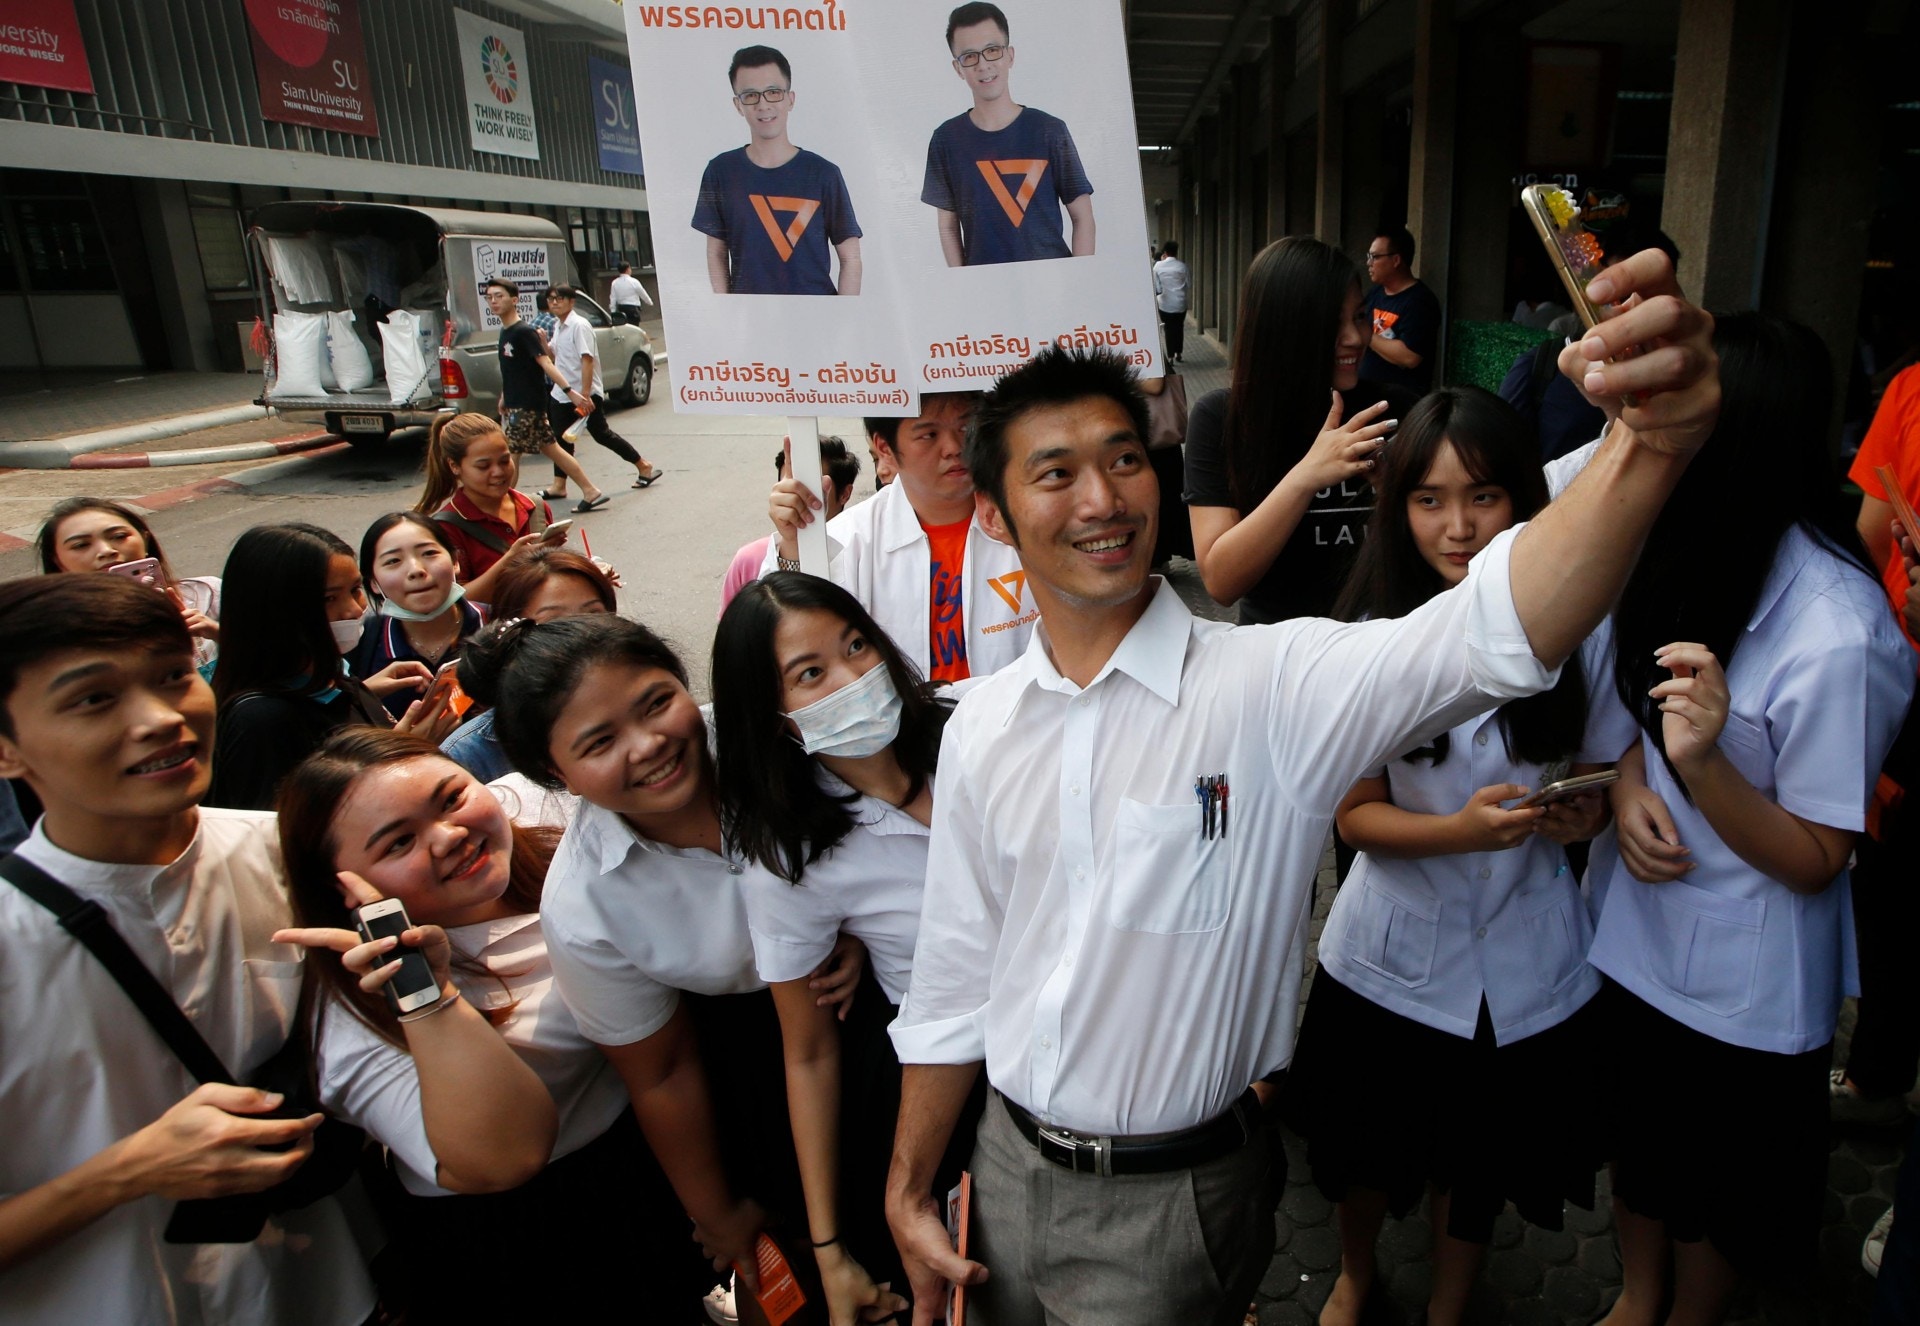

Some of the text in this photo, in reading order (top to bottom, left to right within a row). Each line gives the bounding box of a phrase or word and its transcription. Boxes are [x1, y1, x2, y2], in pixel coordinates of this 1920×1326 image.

[27, 48, 64, 63] WISELY
[281, 81, 362, 113] Siam University
[283, 100, 302, 110] THINK
[325, 108, 344, 117] WORK
[345, 111, 364, 121] WISELY
[474, 103, 532, 127] THINK FREELY
[475, 119, 534, 142] WORK WISELY
[929, 334, 1030, 358] ภาษีเจริญ
[688, 360, 790, 387] ภาษีเจริญ
[817, 361, 896, 384] ตลิ่งชัน
